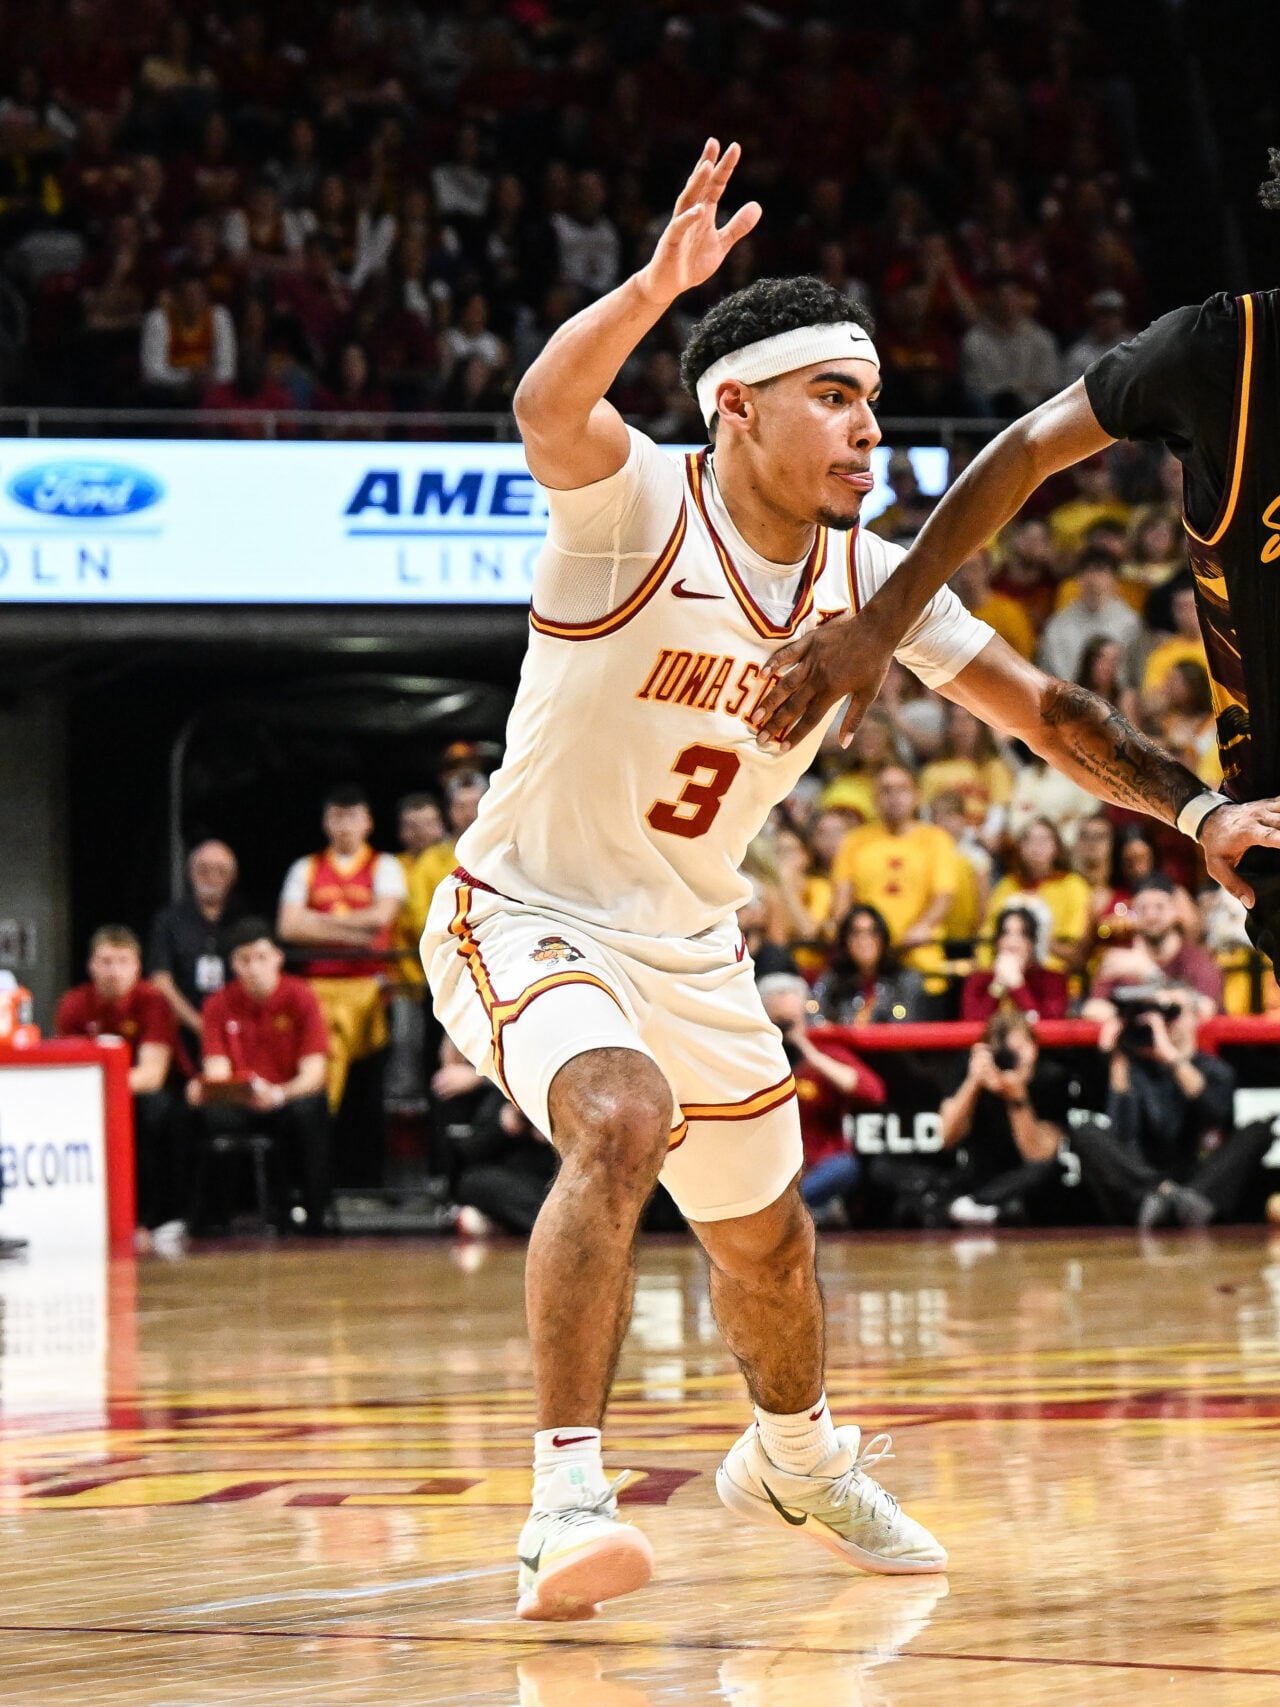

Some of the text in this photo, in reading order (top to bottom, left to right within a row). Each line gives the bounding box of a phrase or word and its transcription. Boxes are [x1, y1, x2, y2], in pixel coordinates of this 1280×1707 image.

[34, 464, 137, 513] Ford
[345, 471, 549, 517] AME
[0, 545, 110, 582] LN
[635, 648, 735, 712] IOWA
[645, 741, 741, 840] 3
[842, 1112, 944, 1154] IELD
[0, 1142, 94, 1190] acom
